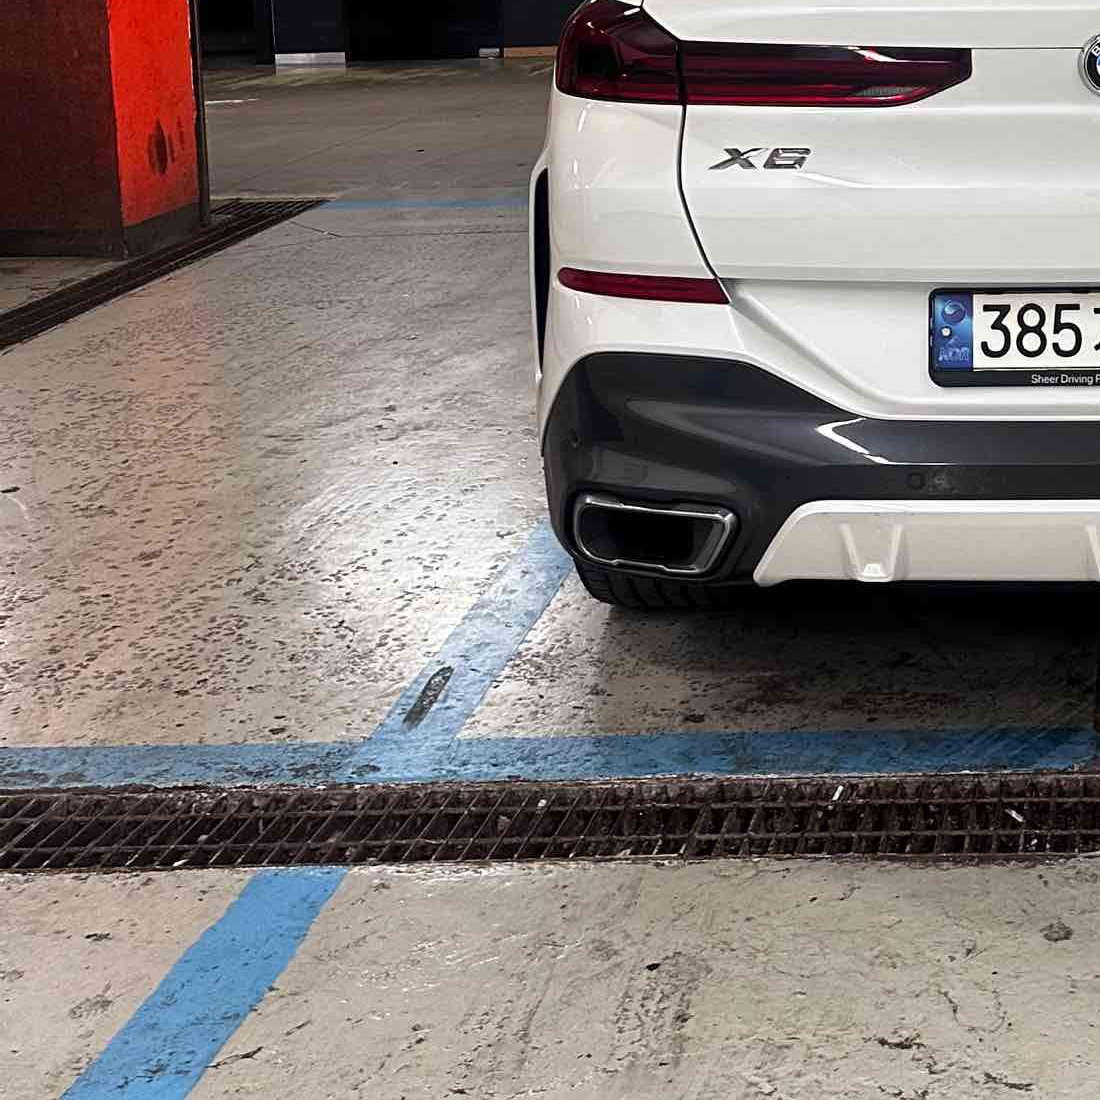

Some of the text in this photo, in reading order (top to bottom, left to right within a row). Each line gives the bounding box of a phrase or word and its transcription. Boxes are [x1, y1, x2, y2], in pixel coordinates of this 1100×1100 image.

[709, 147, 811, 170] X6
[1031, 373, 1059, 385] Sheer
[1060, 373, 1094, 386] Driving
